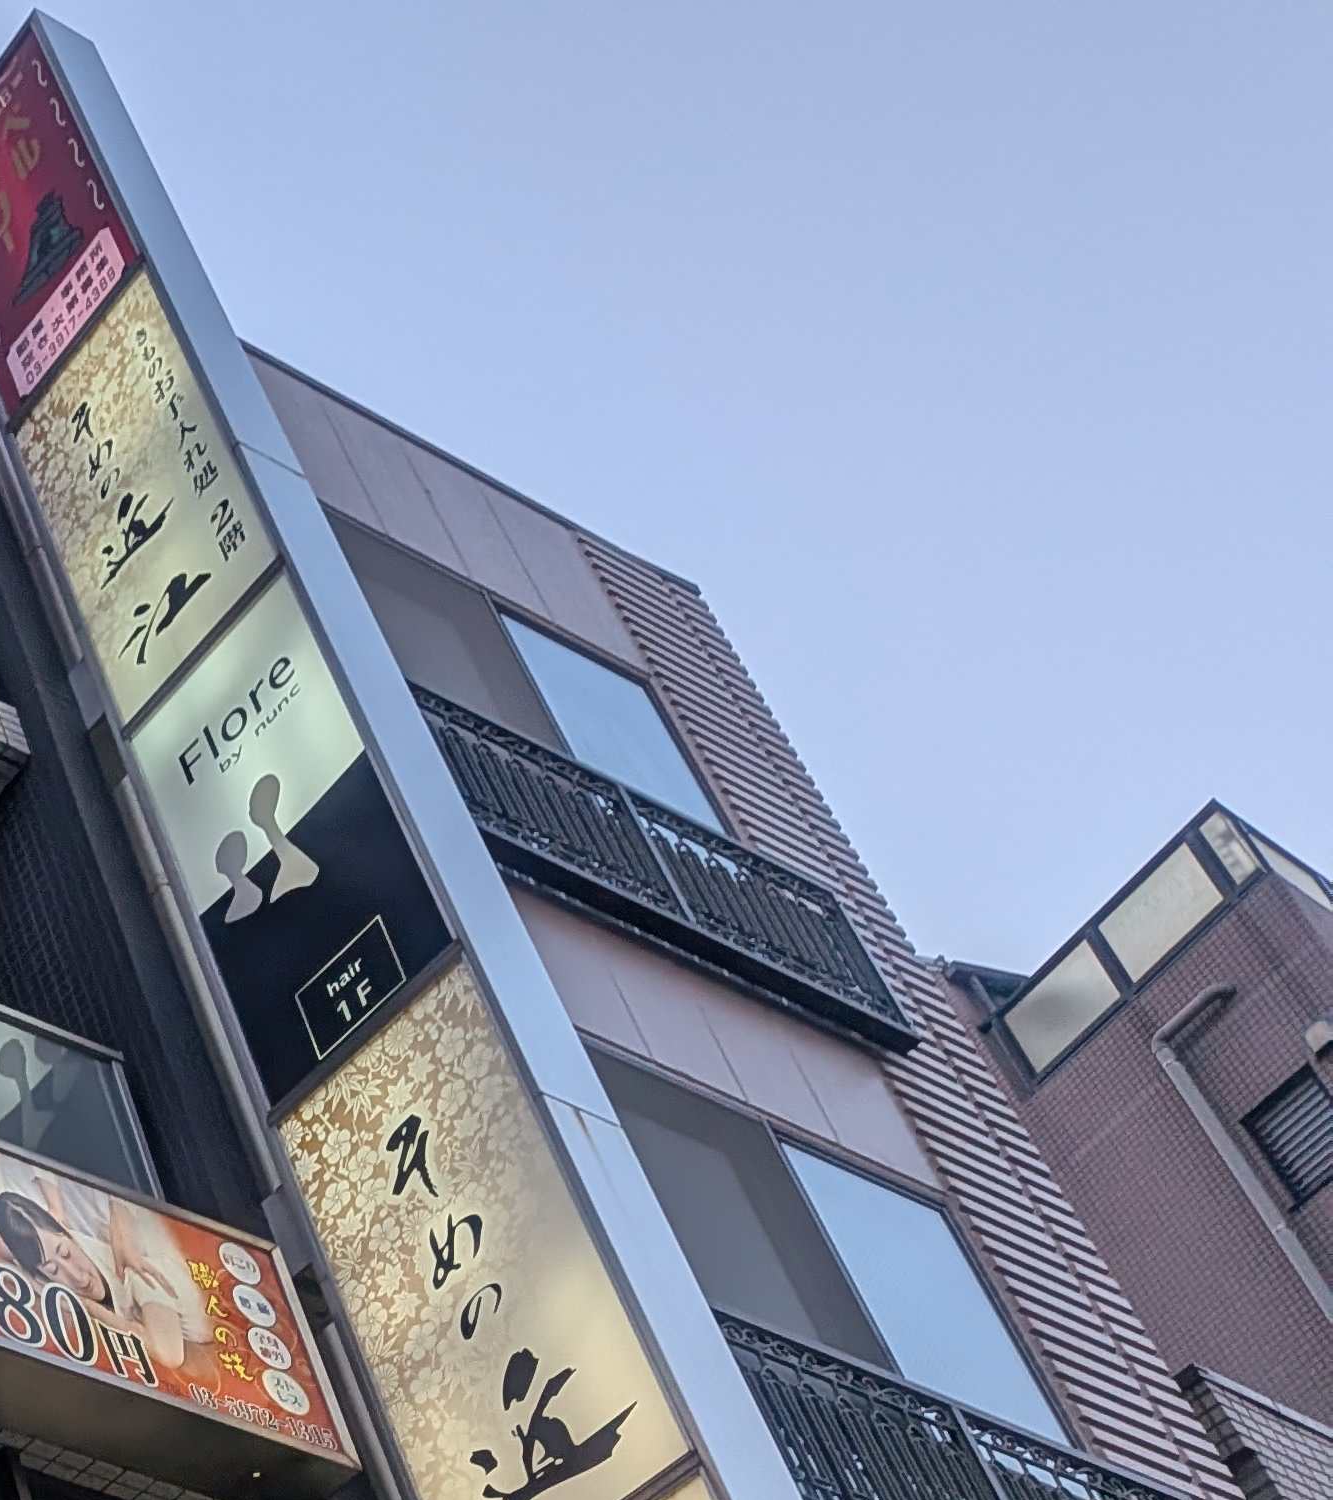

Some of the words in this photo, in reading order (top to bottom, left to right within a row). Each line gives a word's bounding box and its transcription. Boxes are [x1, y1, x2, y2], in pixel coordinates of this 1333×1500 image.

[135, 327, 219, 497] きものお手入れ処
[211, 498, 245, 561] 2階
[71, 401, 212, 664] そめの近江
[178, 653, 296, 786] Flore
[218, 747, 244, 775] by
[254, 684, 303, 736] nunc
[326, 957, 363, 997] hair
